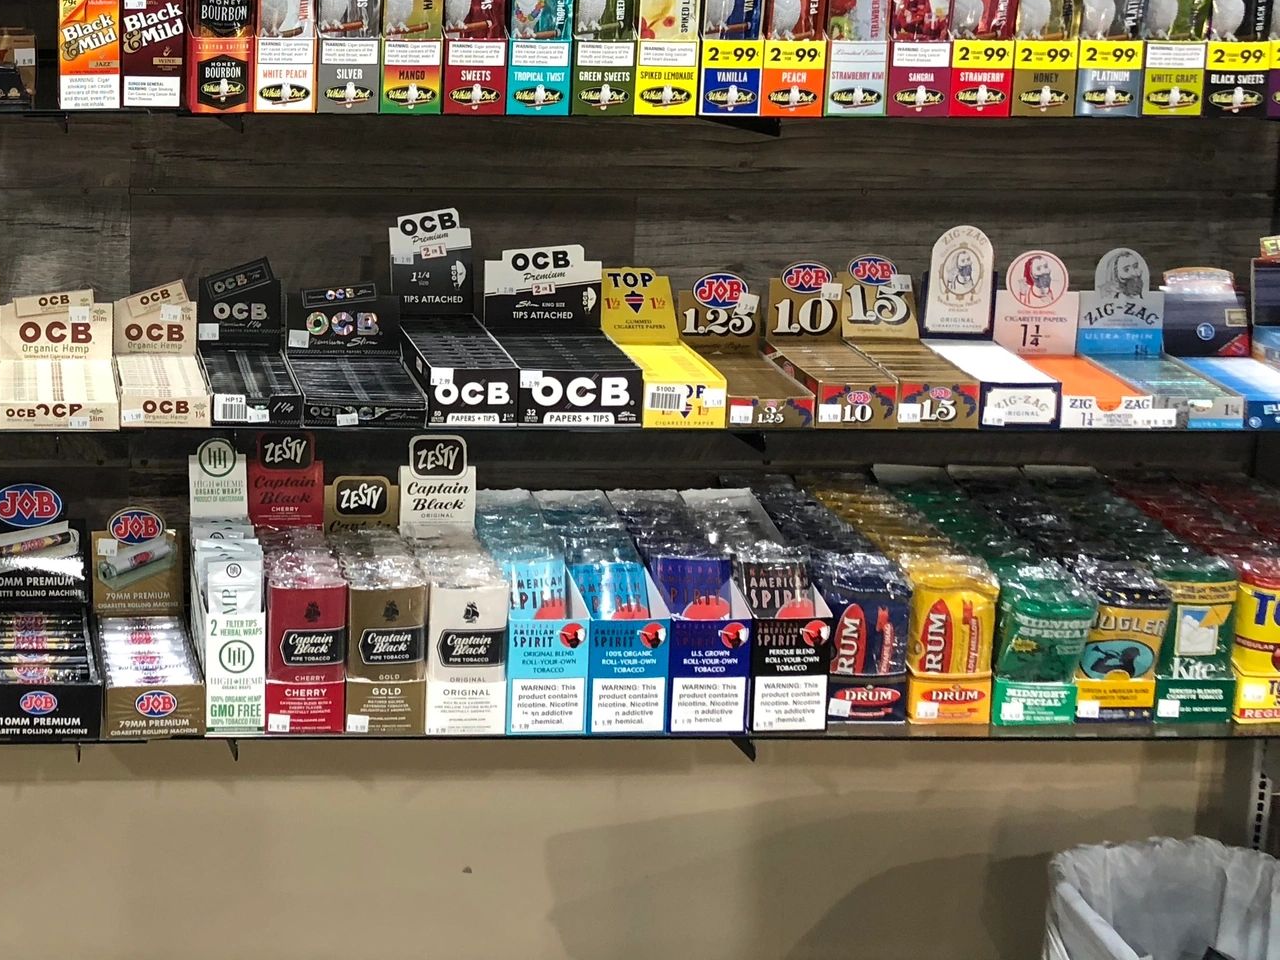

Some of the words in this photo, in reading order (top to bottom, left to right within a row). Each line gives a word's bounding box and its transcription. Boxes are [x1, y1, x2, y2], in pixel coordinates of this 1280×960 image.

[124, 3, 183, 32] Black
[201, 6, 248, 20] BOURBON
[140, 22, 184, 46] Mild
[781, 72, 807, 82] PEACH
[959, 71, 1004, 82] STRAWBERRY
[1211, 73, 1233, 83] BLACK
[1235, 73, 1264, 84] SWEETS
[400, 213, 458, 235] OCB
[608, 273, 654, 289] TOP
[786, 268, 828, 288] JOB
[404, 295, 420, 303] TIPS
[421, 295, 464, 303] ATTACHED
[1084, 302, 1160, 327] ZIG-ZAG
[434, 381, 510, 407] OCB
[407, 481, 469, 497] Captain
[412, 497, 464, 512] Black
[26, 576, 74, 586] PREMIUM
[372, 687, 402, 696] GOLD
[845, 690, 893, 702] DRUM
[210, 705, 235, 717] GMO
[237, 704, 262, 717] FREE
